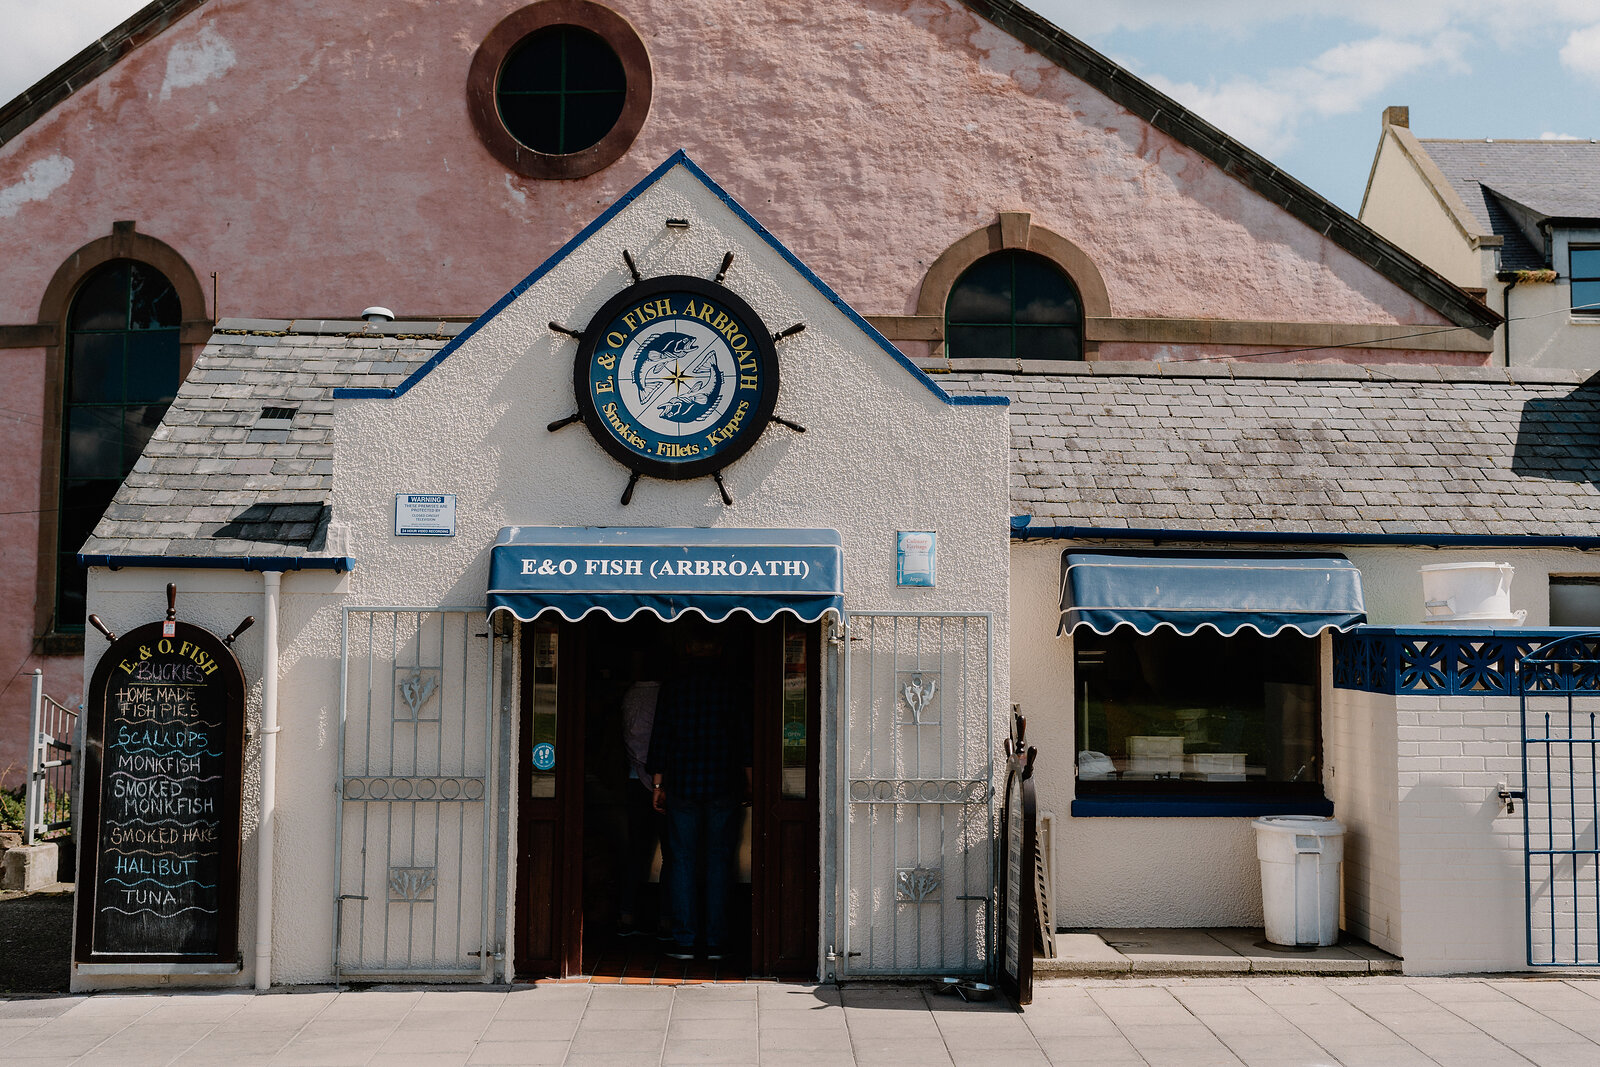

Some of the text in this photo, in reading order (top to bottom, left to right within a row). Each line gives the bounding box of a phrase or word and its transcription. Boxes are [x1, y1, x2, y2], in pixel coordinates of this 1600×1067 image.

[596, 298, 758, 394] E. & O. FISH. ARBROATH
[602, 400, 750, 457] Smokies Fillets Kippers
[521, 559, 810, 580] E&O FISH (ARBROATH)
[118, 639, 219, 676] E. & O. FISH
[137, 661, 204, 682] BUCKIES
[115, 687, 196, 703] HOME MADE
[120, 703, 199, 718] FISH PIES
[118, 726, 208, 748] SCALLOPS
[118, 755, 201, 773] MONKFISH
[114, 779, 182, 798] SMOKED
[124, 797, 213, 815] MONKFISH
[111, 827, 218, 844] SMOKED HAKE
[115, 856, 198, 876] HALIBUT
[120, 889, 177, 905] TUNA
